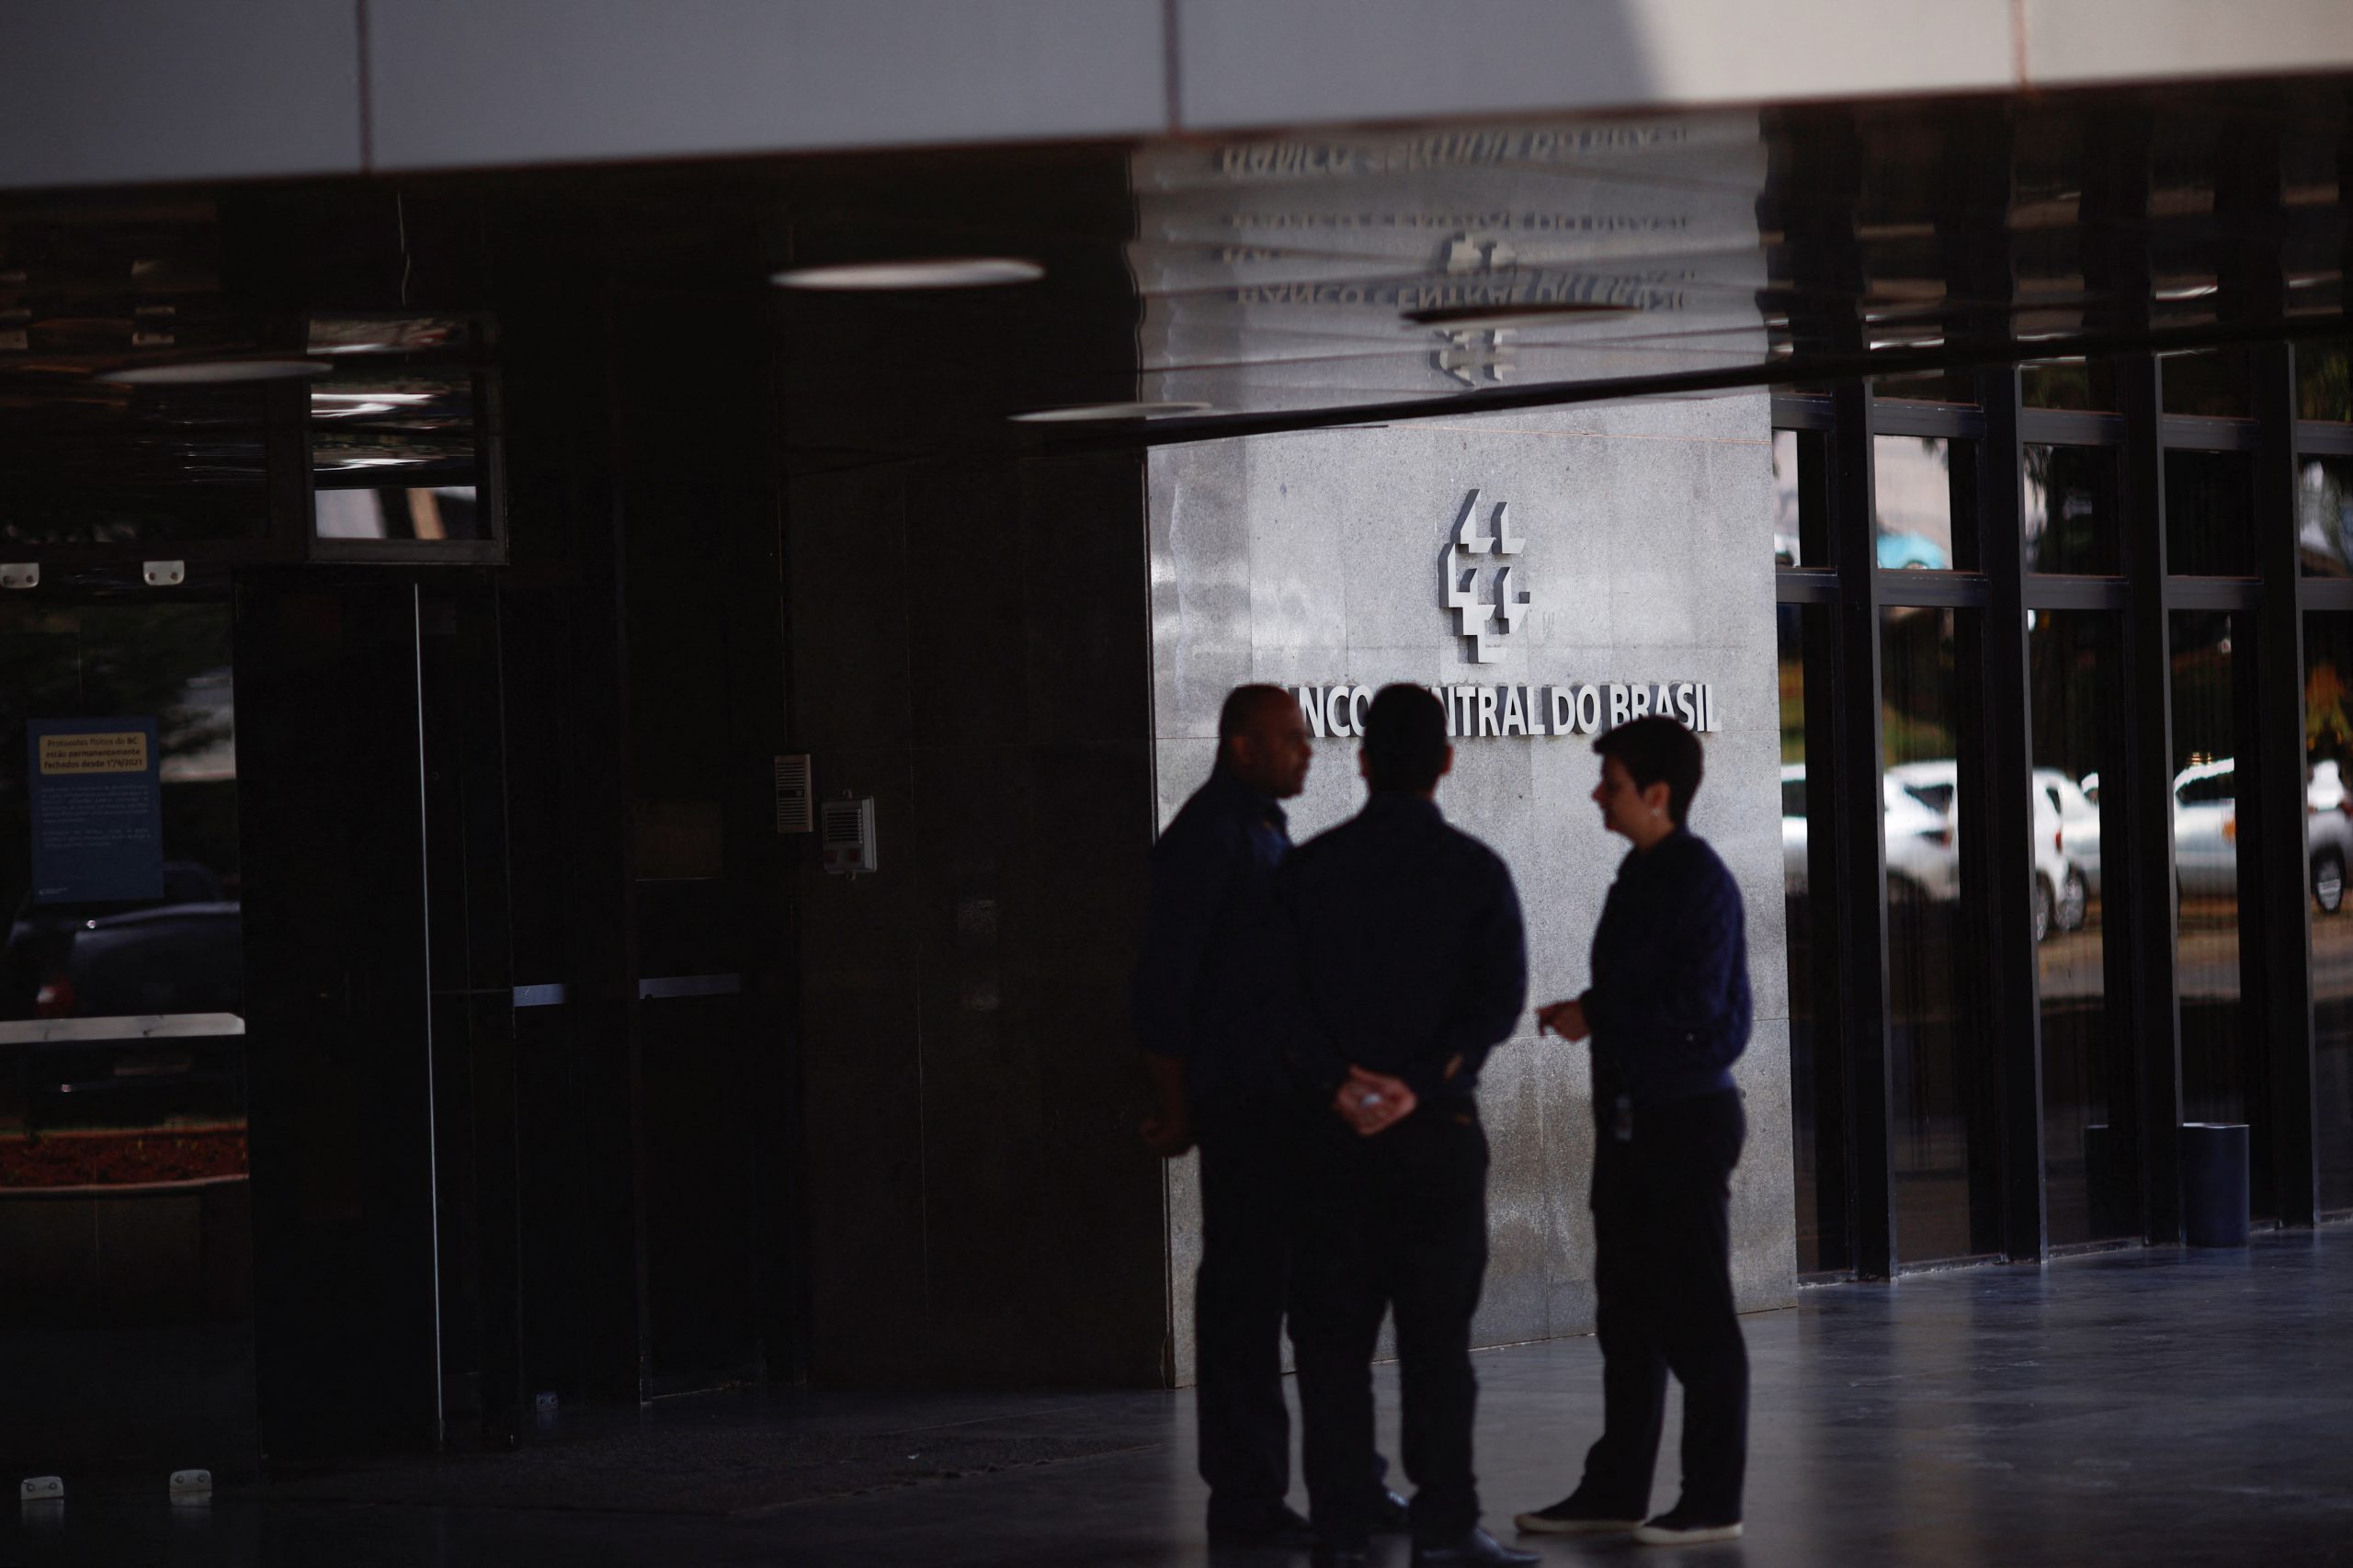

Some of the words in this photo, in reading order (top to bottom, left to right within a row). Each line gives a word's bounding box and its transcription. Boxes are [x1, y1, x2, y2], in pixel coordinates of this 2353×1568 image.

[1291, 685, 1374, 737] NCO
[1426, 686, 1545, 736] NTRAL
[1552, 685, 1601, 735] DO
[1610, 684, 1722, 733] BRASIL
[44, 760, 79, 769] fechados
[81, 759, 104, 767] desde
